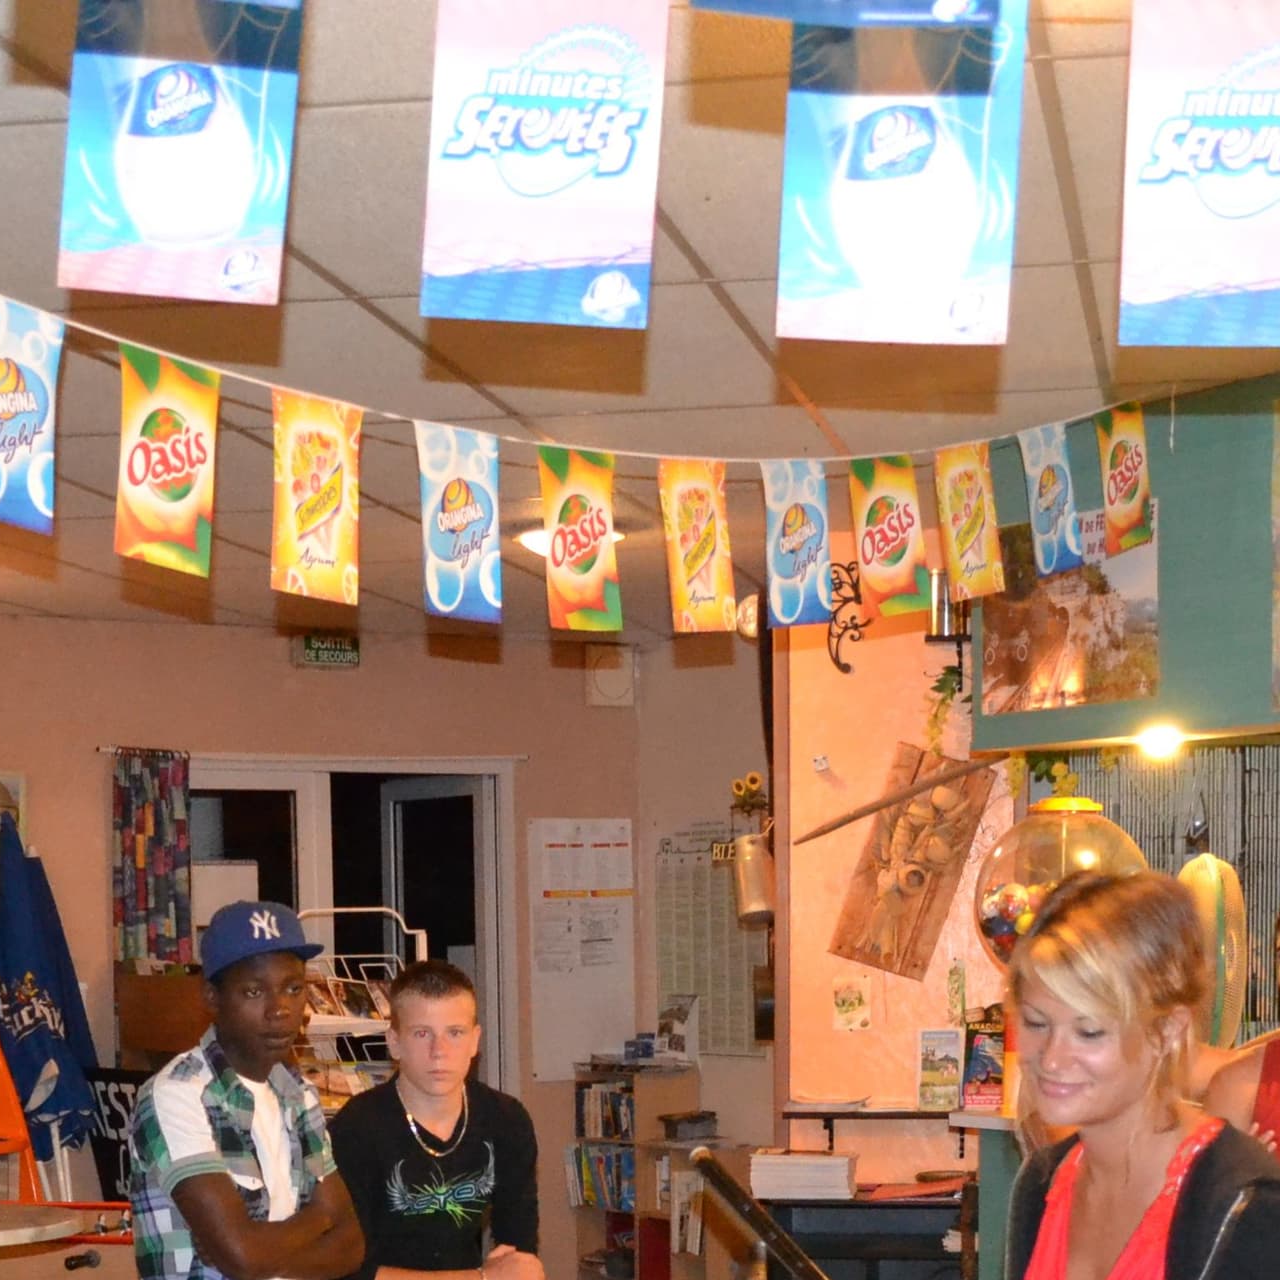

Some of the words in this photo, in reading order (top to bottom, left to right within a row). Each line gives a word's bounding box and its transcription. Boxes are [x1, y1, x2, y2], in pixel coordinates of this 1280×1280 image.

[127, 426, 208, 487] Oasis
[1107, 443, 1144, 507] Oasis
[551, 505, 608, 568] Oasis
[860, 499, 915, 567] Oasis
